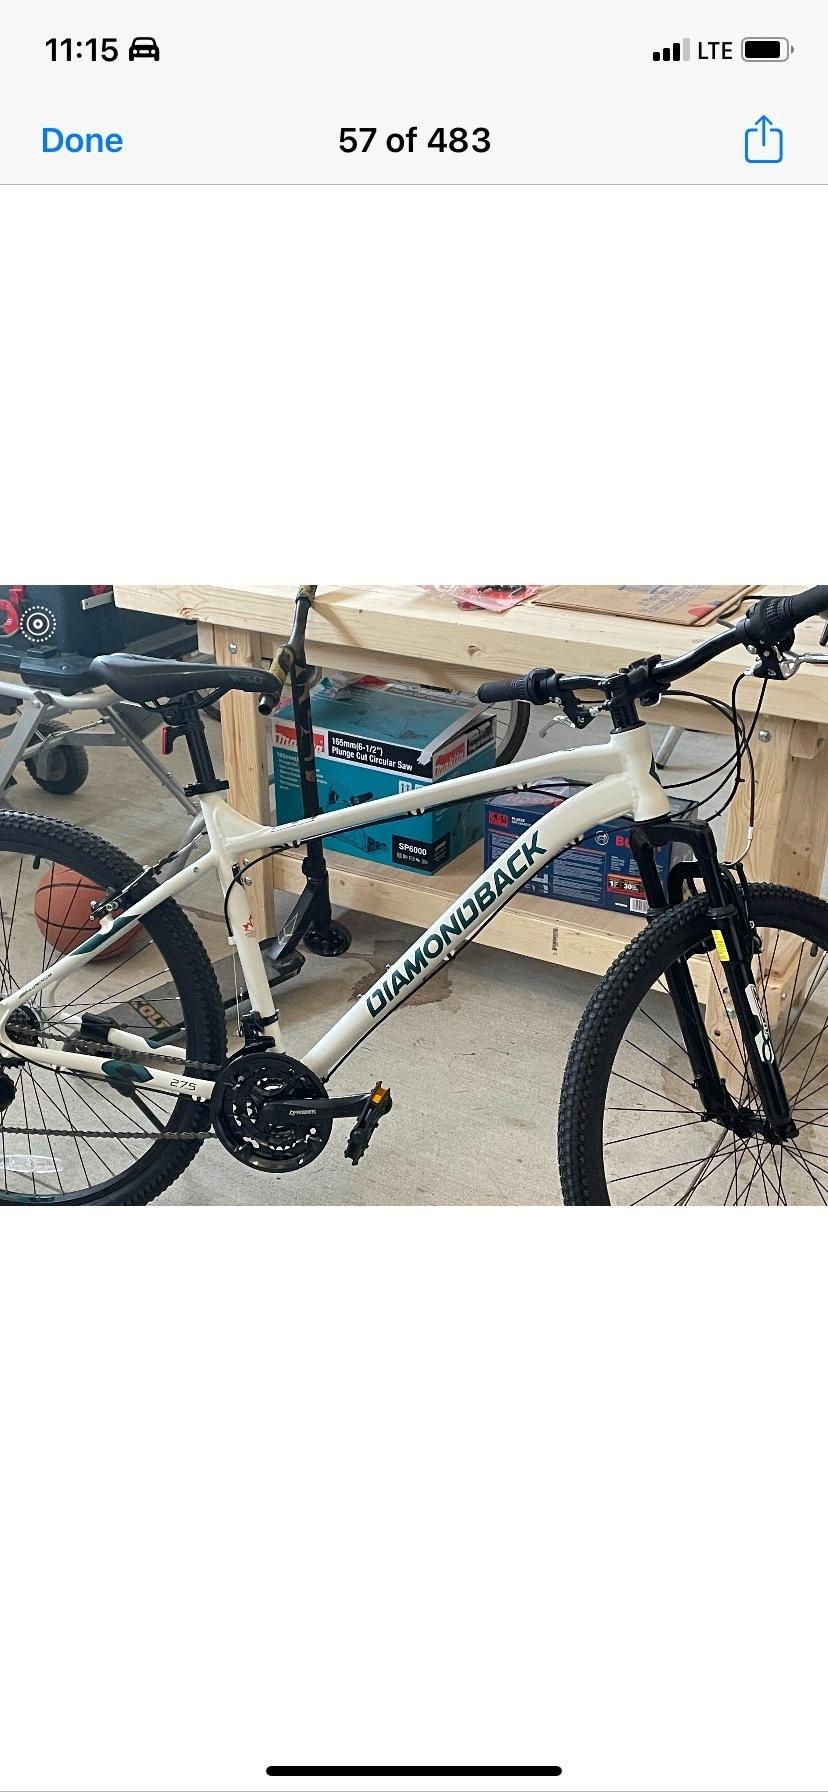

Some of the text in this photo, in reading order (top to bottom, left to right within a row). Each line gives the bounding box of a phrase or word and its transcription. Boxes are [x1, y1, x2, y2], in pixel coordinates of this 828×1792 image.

[45, 37, 119, 62] 11:15
[697, 41, 733, 60] LTE
[42, 127, 124, 153] Done
[338, 125, 491, 153] 57 of 483
[331, 745, 413, 772] Plunge Cut Circular Saw
[398, 842, 427, 856] SP6000
[365, 829, 548, 1019] DIAMONDBACK
